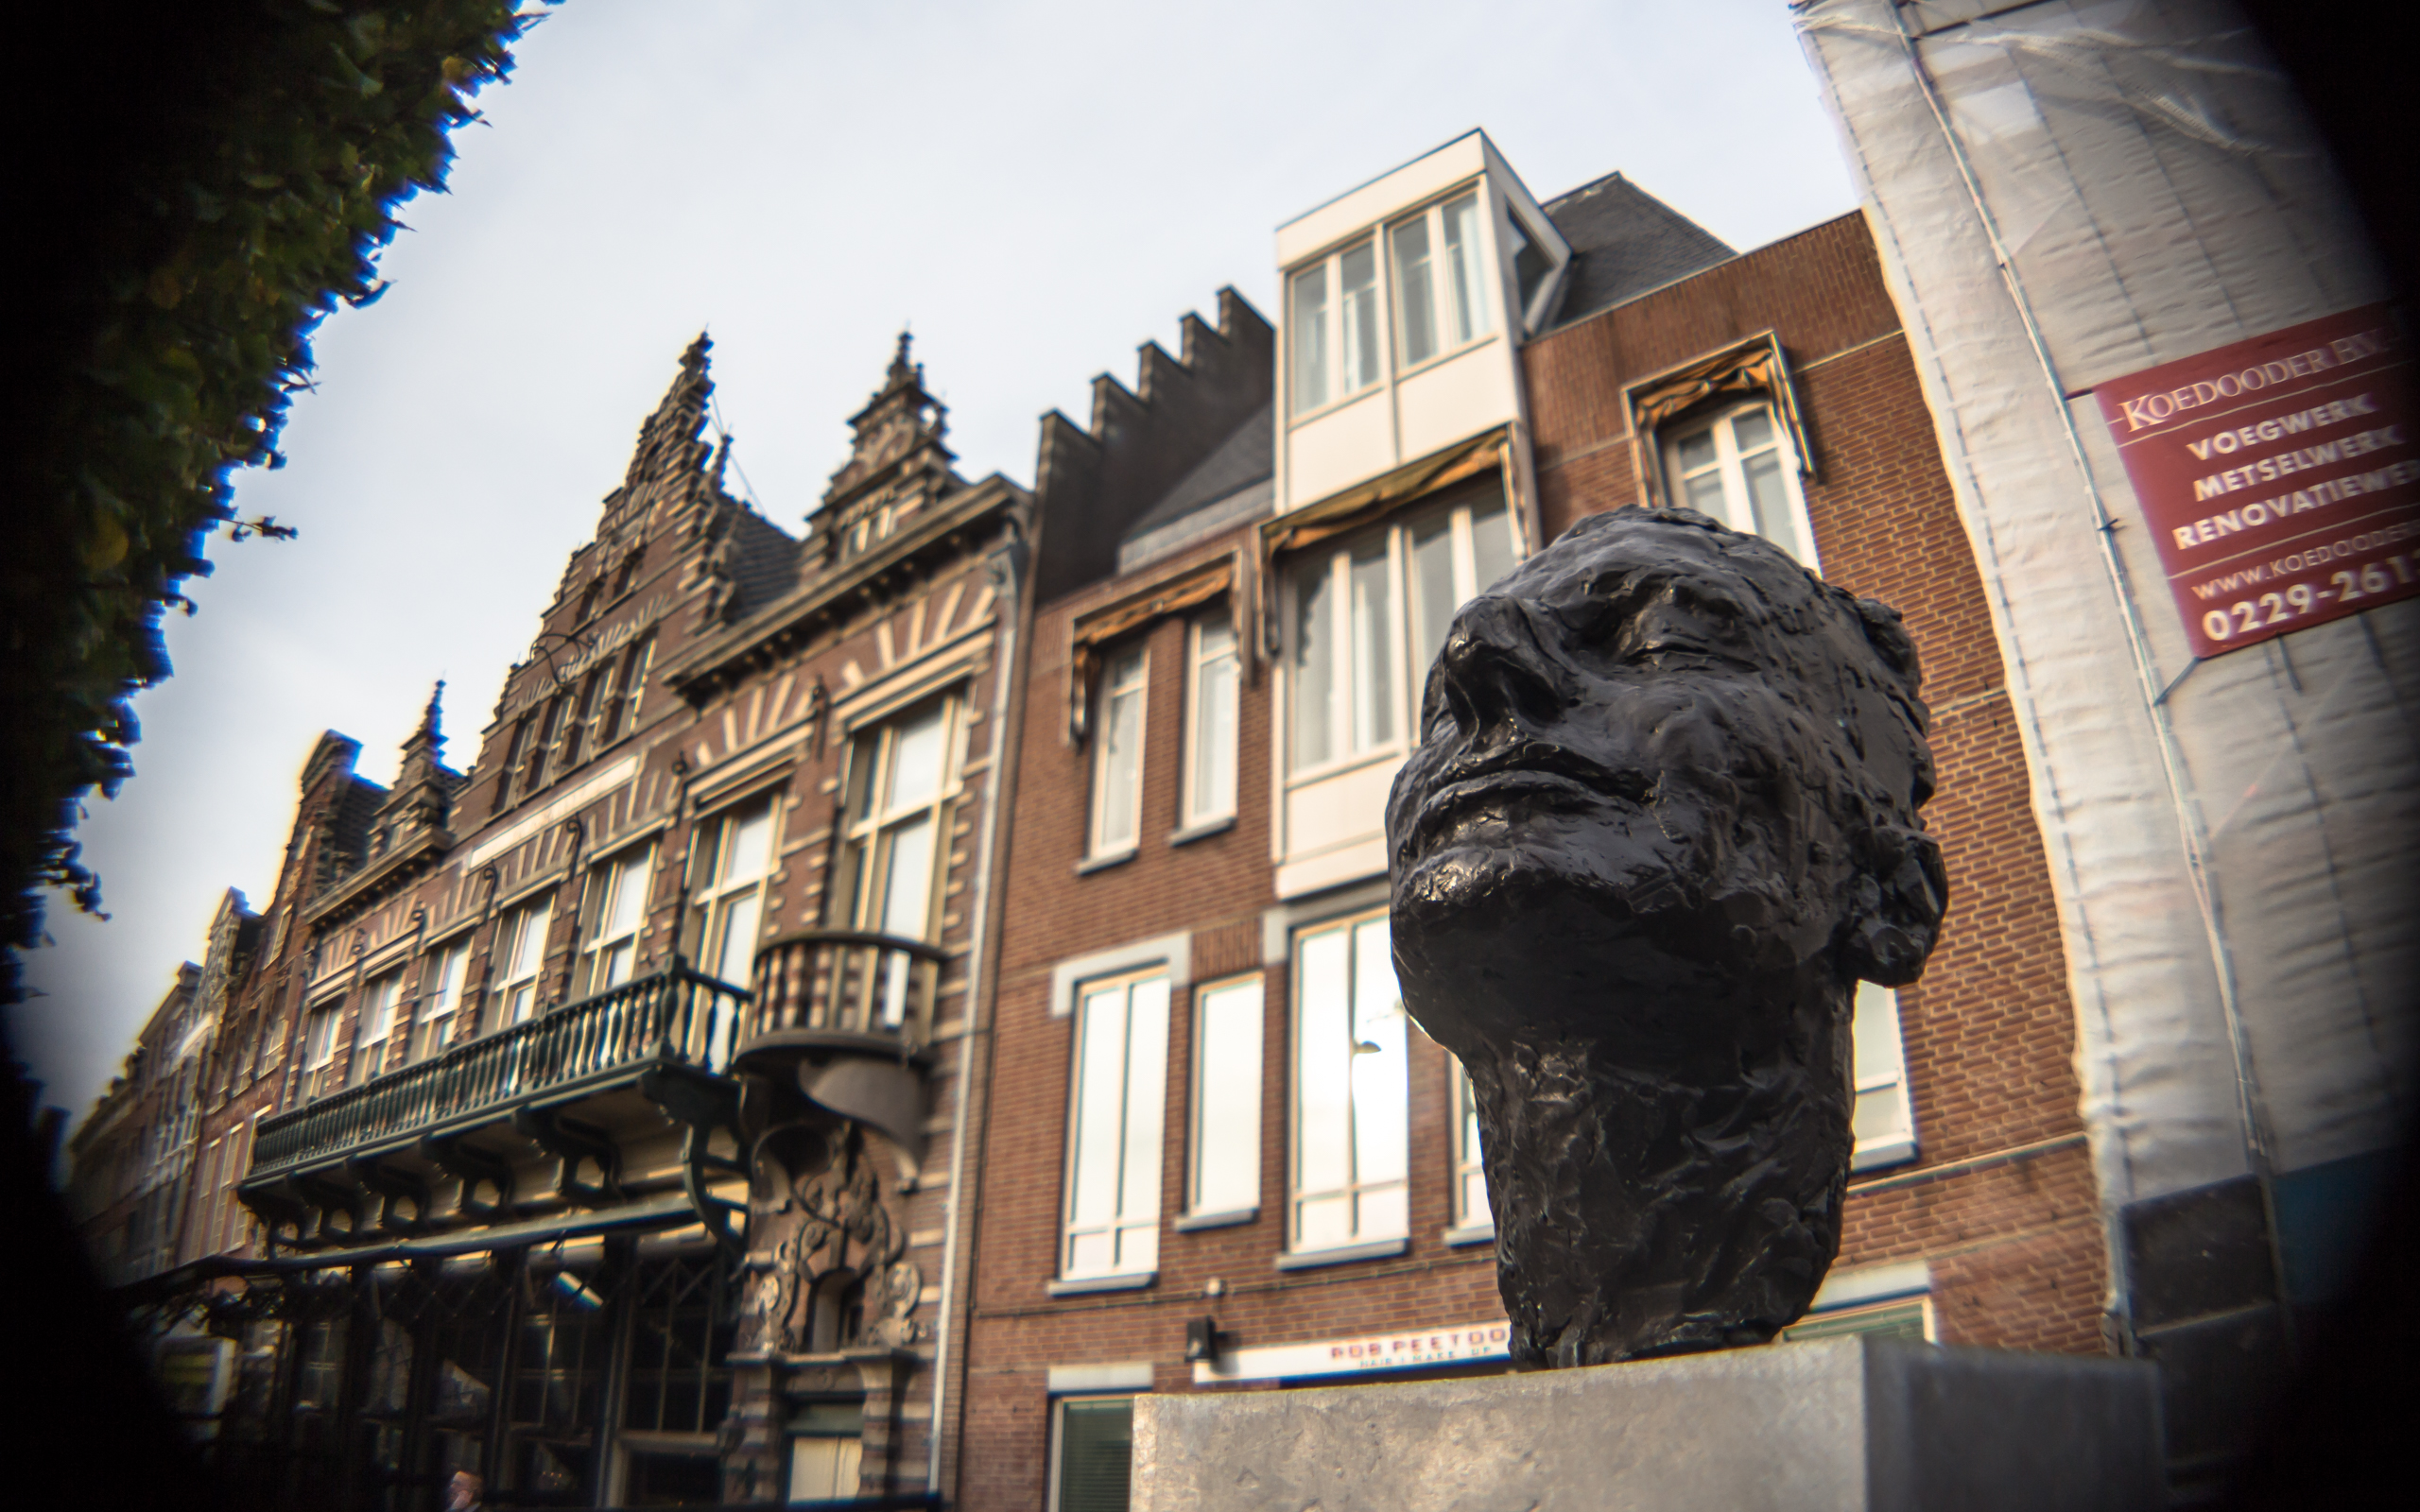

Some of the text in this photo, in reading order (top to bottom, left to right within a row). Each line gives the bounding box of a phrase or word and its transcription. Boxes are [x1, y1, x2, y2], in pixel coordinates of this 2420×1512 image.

[2118, 348, 2332, 433] KOEDOODER
[2186, 393, 2380, 461] VOEGWERK
[2193, 424, 2408, 502] METSELWERK
